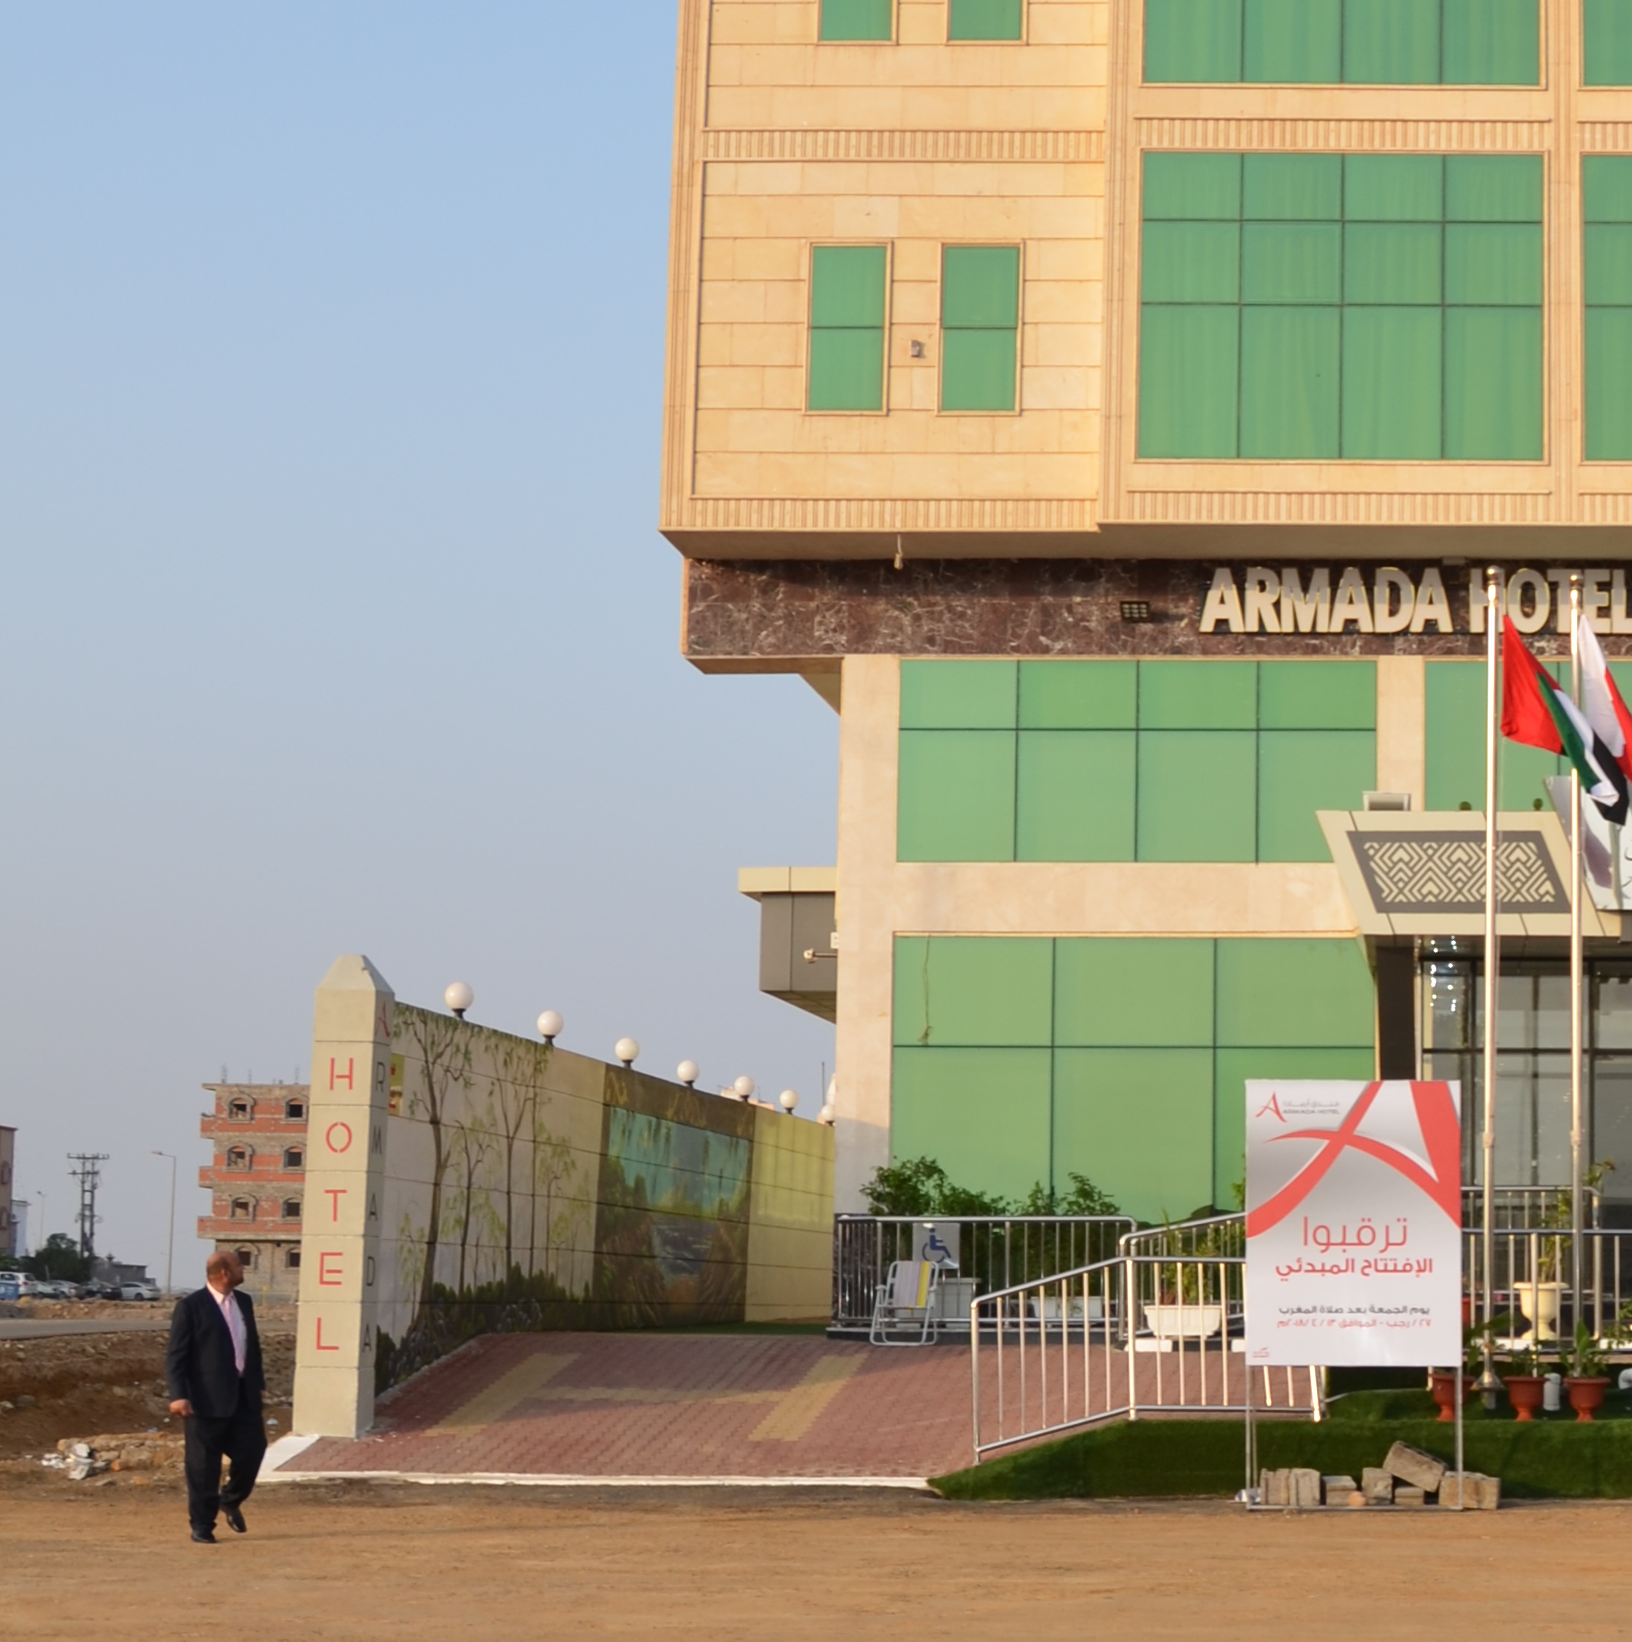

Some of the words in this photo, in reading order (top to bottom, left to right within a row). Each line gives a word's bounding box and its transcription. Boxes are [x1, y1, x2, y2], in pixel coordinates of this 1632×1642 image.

[1200, 566, 1453, 633] ARMADA
[316, 1057, 354, 1351] HOTEL
[1303, 1216, 1408, 1254] ترقبوا
[1275, 1257, 1355, 1282] المبدئي
[1360, 1257, 1433, 1278] الإفتتاح
[1278, 1305, 1318, 1316] المغرب
[1368, 1303, 1408, 1315] الجمعة
[1409, 1306, 1431, 1316] يوم
